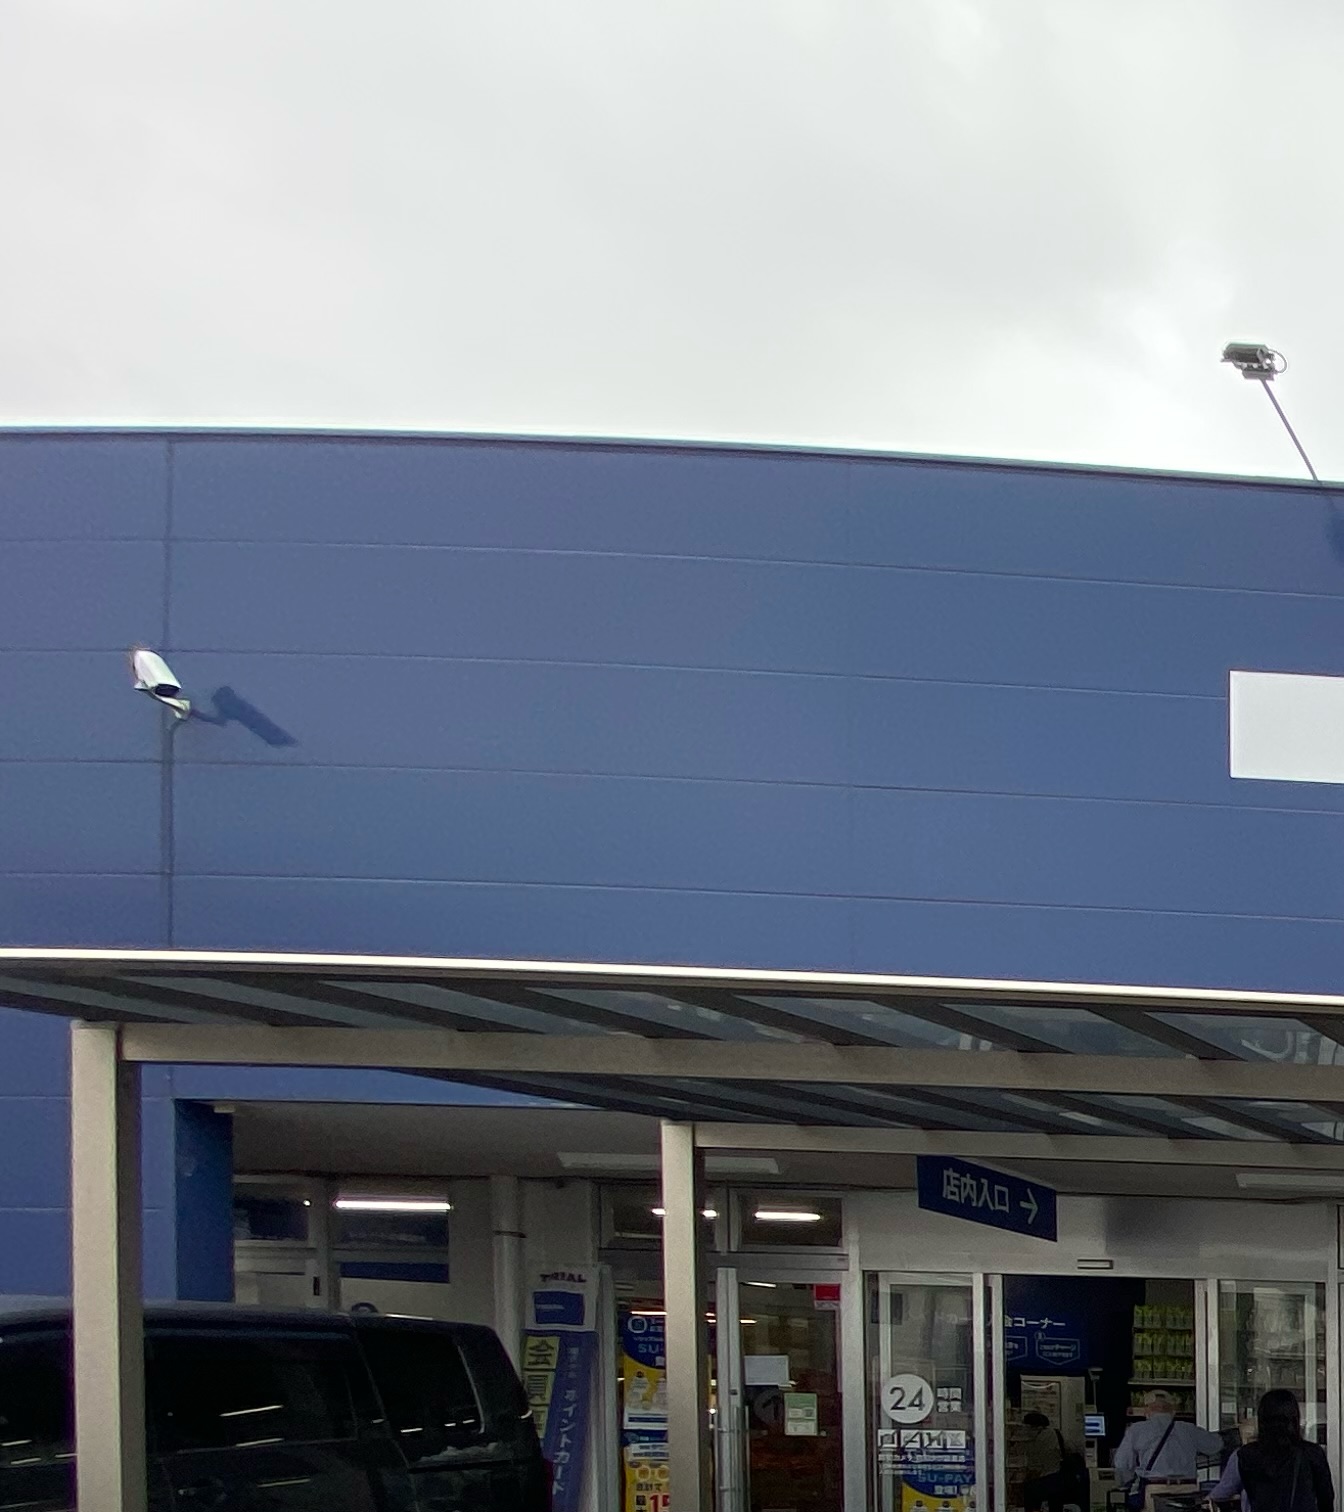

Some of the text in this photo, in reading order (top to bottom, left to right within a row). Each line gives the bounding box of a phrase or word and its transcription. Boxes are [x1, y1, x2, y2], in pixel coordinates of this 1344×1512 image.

[942, 1167, 1010, 1213] 店内入口
[540, 1272, 587, 1284] TRIAL
[889, 1385, 926, 1411] 24
